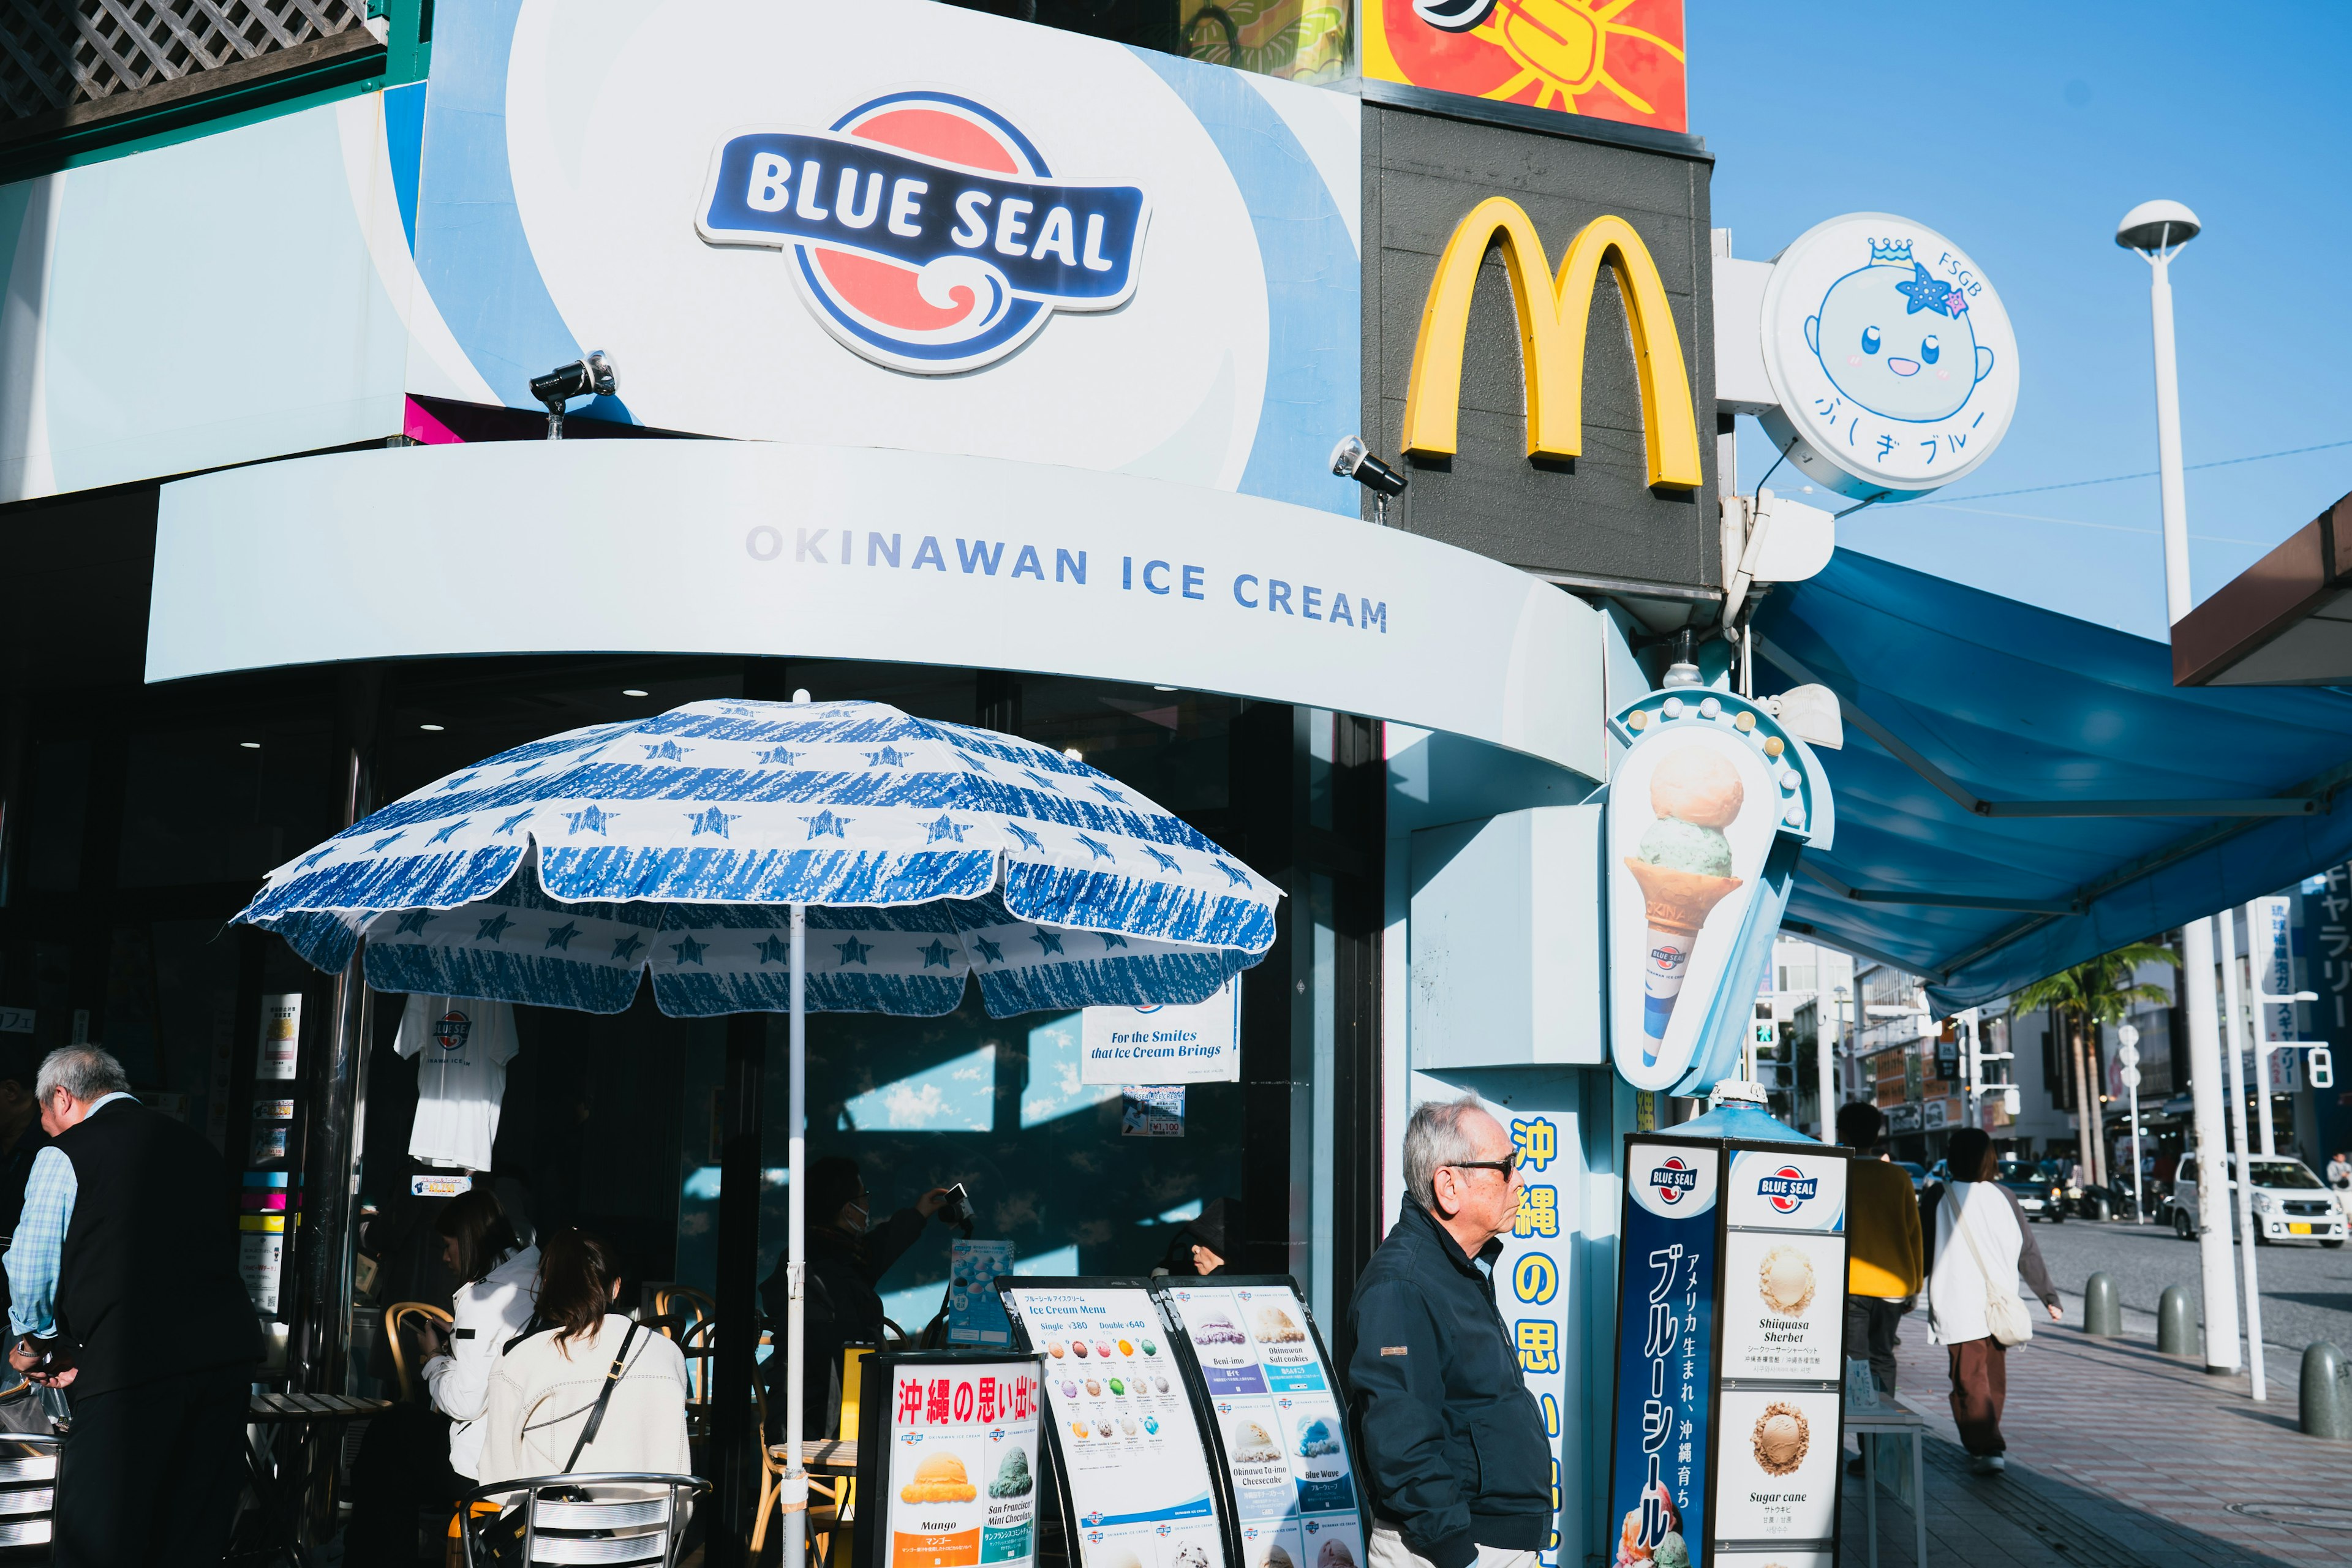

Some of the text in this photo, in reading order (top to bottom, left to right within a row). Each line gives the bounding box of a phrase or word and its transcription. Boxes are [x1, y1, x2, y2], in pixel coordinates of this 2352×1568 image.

[747, 152, 1114, 272] BLUE SEAL
[1939, 252, 1982, 297] FSGB
[745, 524, 1387, 634] OKINAWAN ICE CREAM
[1653, 951, 1668, 960] BLUE
[1112, 1030, 1197, 1043] For the Smiles
[1091, 1045, 1221, 1059] that Ice Cream Brings
[1653, 1171, 1694, 1186] BLUE SEAL
[429, 1183, 454, 1193] ¥2,750
[1761, 1182, 1814, 1195] BLUE SEAL
[1080, 1305, 1106, 1314] Menu
[1759, 1318, 1809, 1332] Shiiquasa
[1764, 1332, 1803, 1343] Sherbet
[1677, 1253, 1700, 1509] アメリカ生まれ、沖縄育ち
[898, 1375, 1037, 1425] 沖縄の思い出に
[1637, 1243, 1684, 1550] ブルーシール
[1234, 1468, 1263, 1476] Okinawa
[1242, 1476, 1282, 1485] Cheesecake
[1750, 1491, 1807, 1504] Sugar cane
[988, 1505, 1002, 1515] San
[987, 1511, 1032, 1526] Mint Chocolate
[921, 1521, 957, 1532] Mango
[925, 1537, 951, 1545] マンゴー
